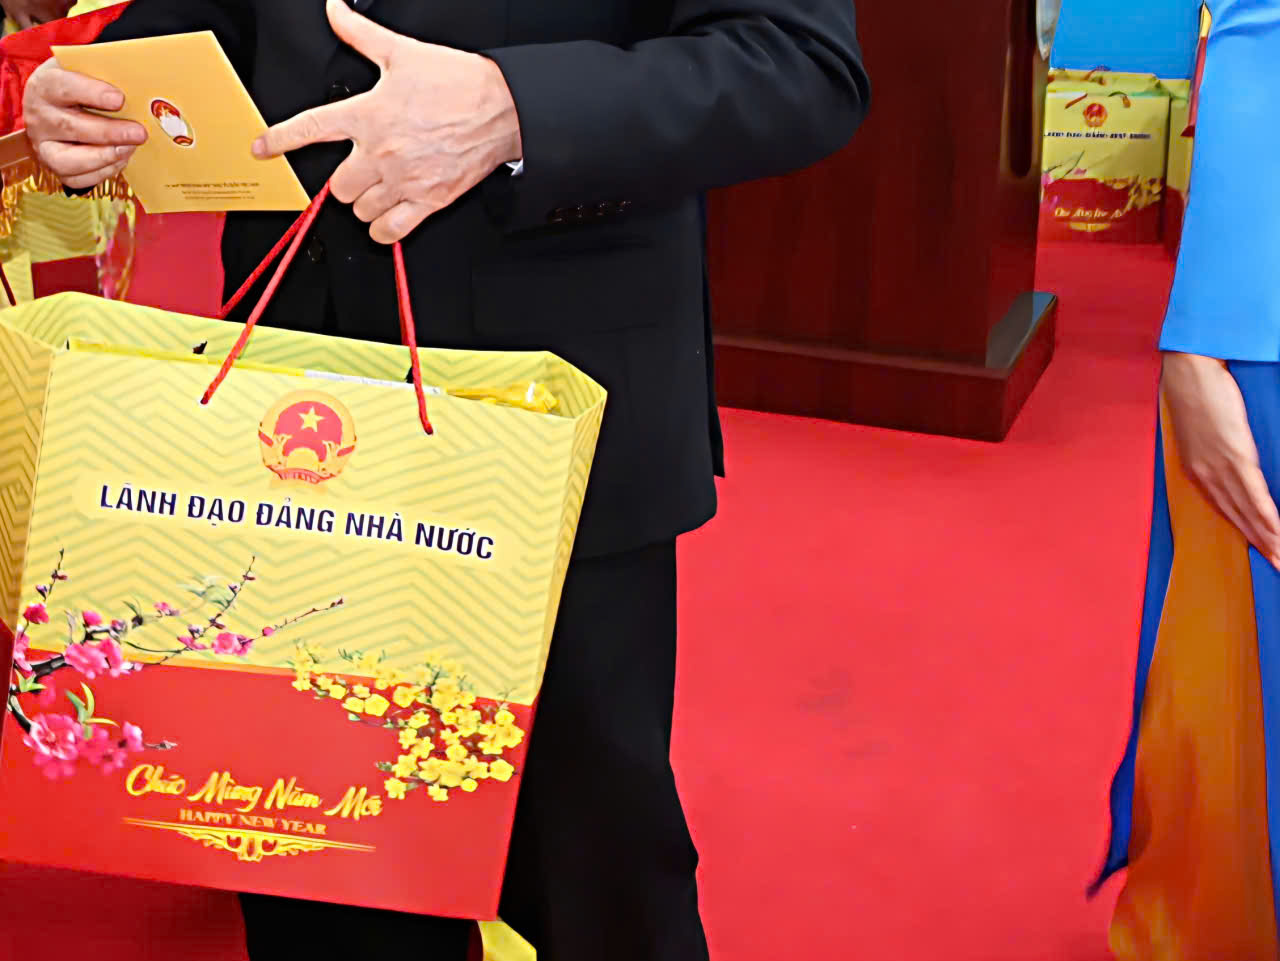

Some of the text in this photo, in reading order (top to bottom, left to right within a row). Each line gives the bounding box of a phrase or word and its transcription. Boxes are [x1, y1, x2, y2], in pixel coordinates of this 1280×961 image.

[100, 482, 495, 560] LÃNH ĐẠO ĐẢNG NHÀ NƯỚC
[179, 808, 328, 836] HAPPY NEW YEAR
